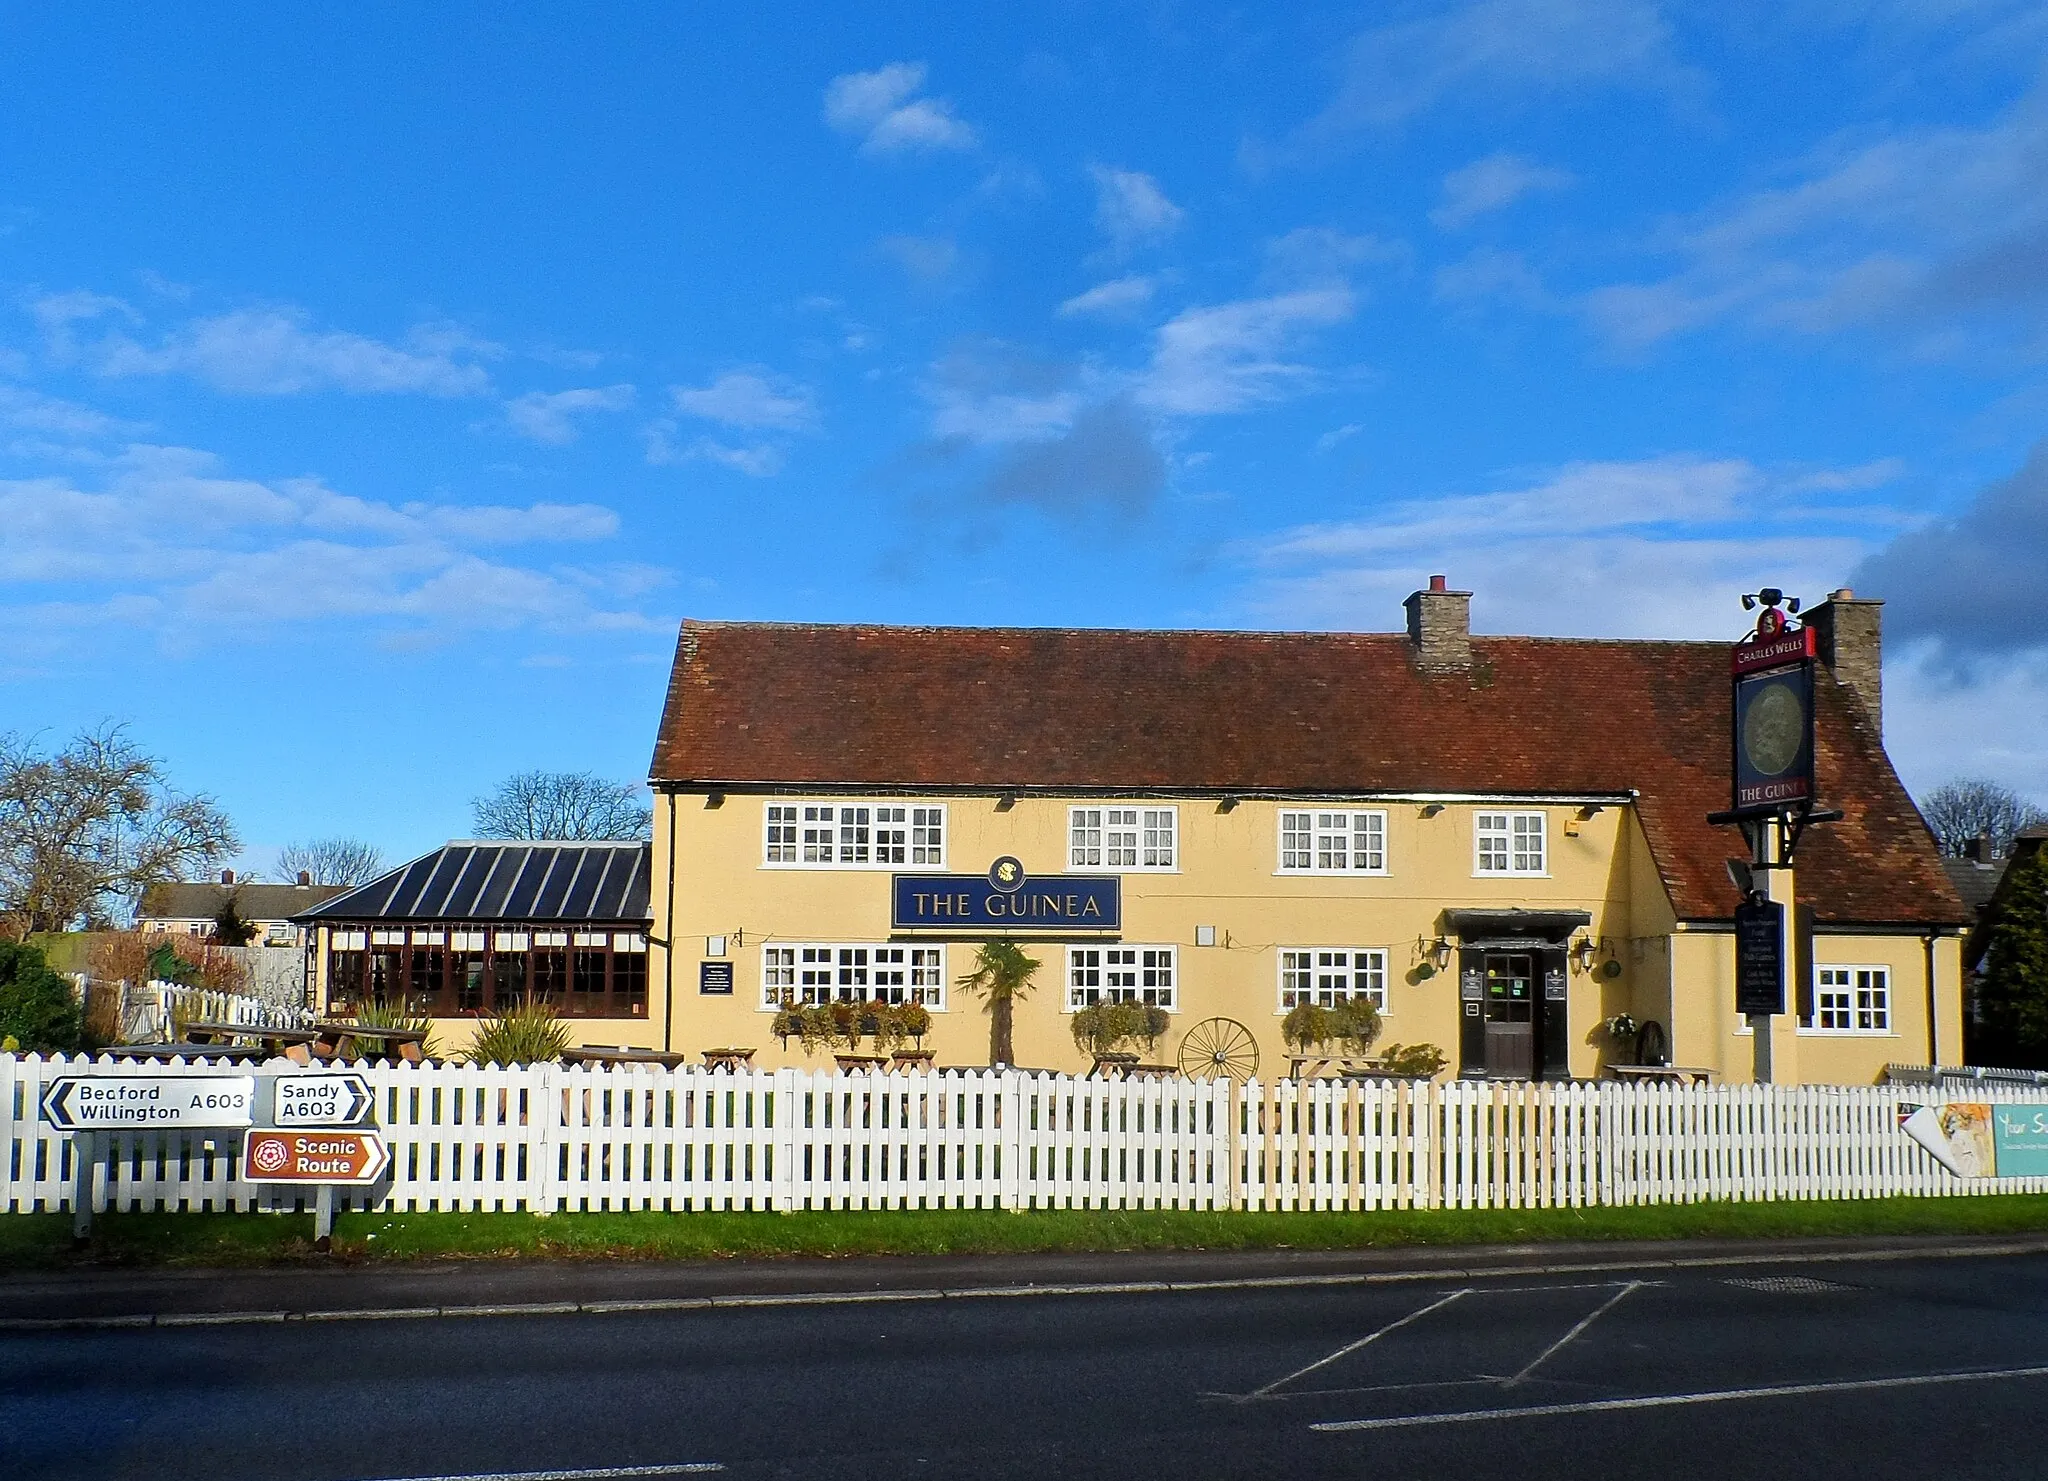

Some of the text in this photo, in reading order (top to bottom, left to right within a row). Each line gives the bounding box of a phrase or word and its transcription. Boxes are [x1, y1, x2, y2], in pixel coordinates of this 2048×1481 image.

[1737, 639, 1803, 664] CHARLES WELLS
[1741, 787, 1761, 801] THE
[912, 893, 1102, 917] THE GUINEA
[283, 1084, 340, 1099] Sandy
[190, 1095, 244, 1109] A603
[282, 1102, 336, 1117] A603
[80, 1105, 180, 1121] Willington
[295, 1137, 356, 1155] Scenic
[296, 1158, 351, 1173] Route
